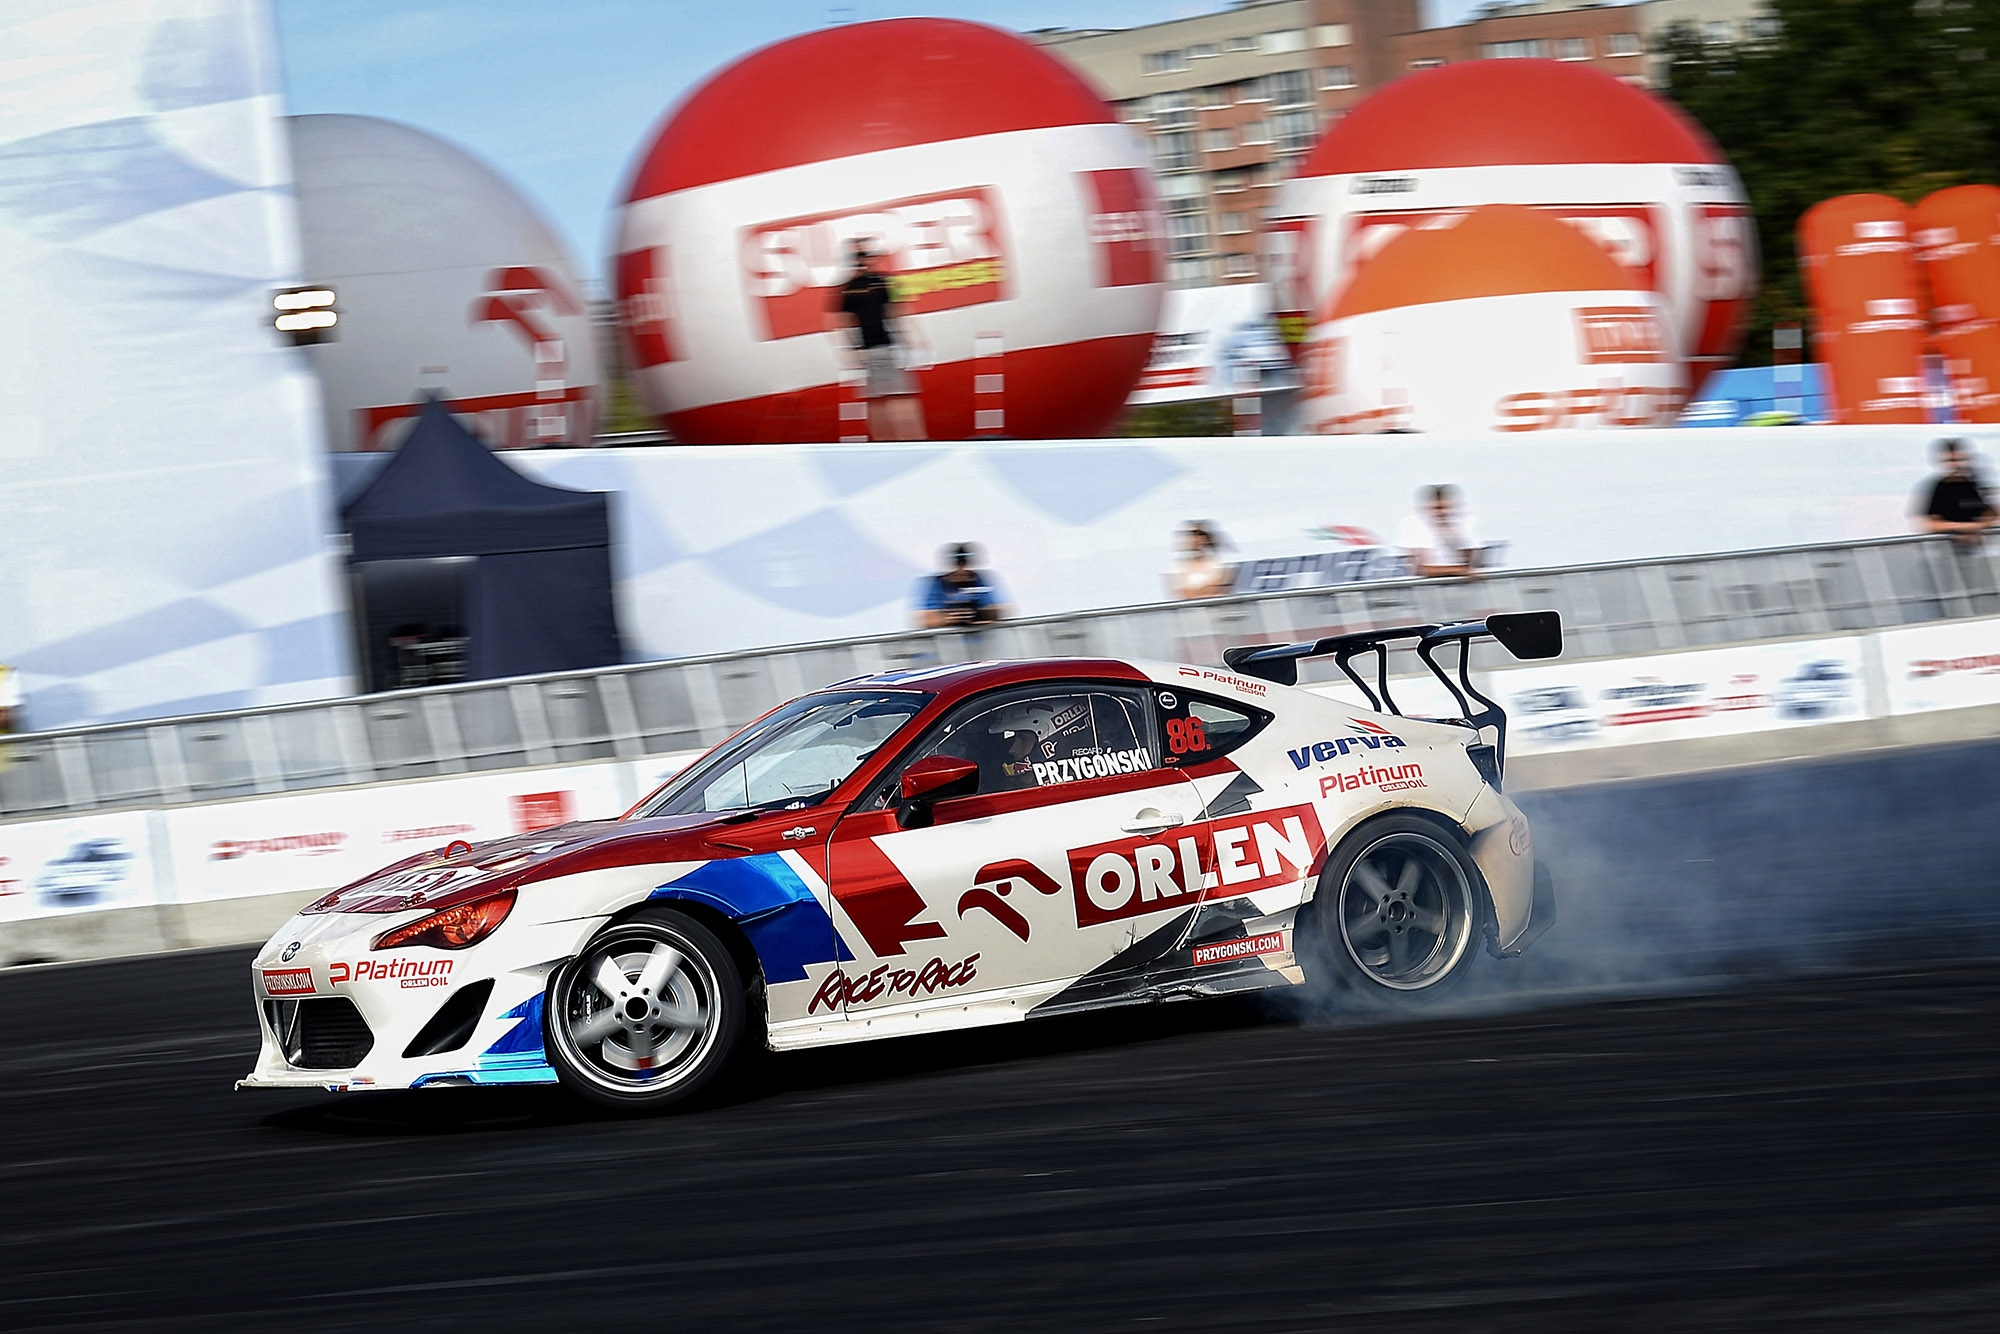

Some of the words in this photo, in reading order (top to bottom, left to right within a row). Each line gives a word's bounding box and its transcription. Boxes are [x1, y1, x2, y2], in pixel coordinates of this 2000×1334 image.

[1203, 671, 1267, 692] Platinum
[1032, 747, 1153, 786] PRZYGOŃSKI
[1287, 736, 1407, 771] verva
[1319, 763, 1424, 799] Platinum
[1408, 779, 1428, 789] OIL
[1085, 816, 1315, 911] ORLEN
[1196, 936, 1281, 963] PRZYGONSKI.COM
[354, 958, 453, 982] Platinum
[430, 977, 449, 987] OIL
[808, 961, 889, 1016] RACE
[909, 953, 981, 997] RACE
